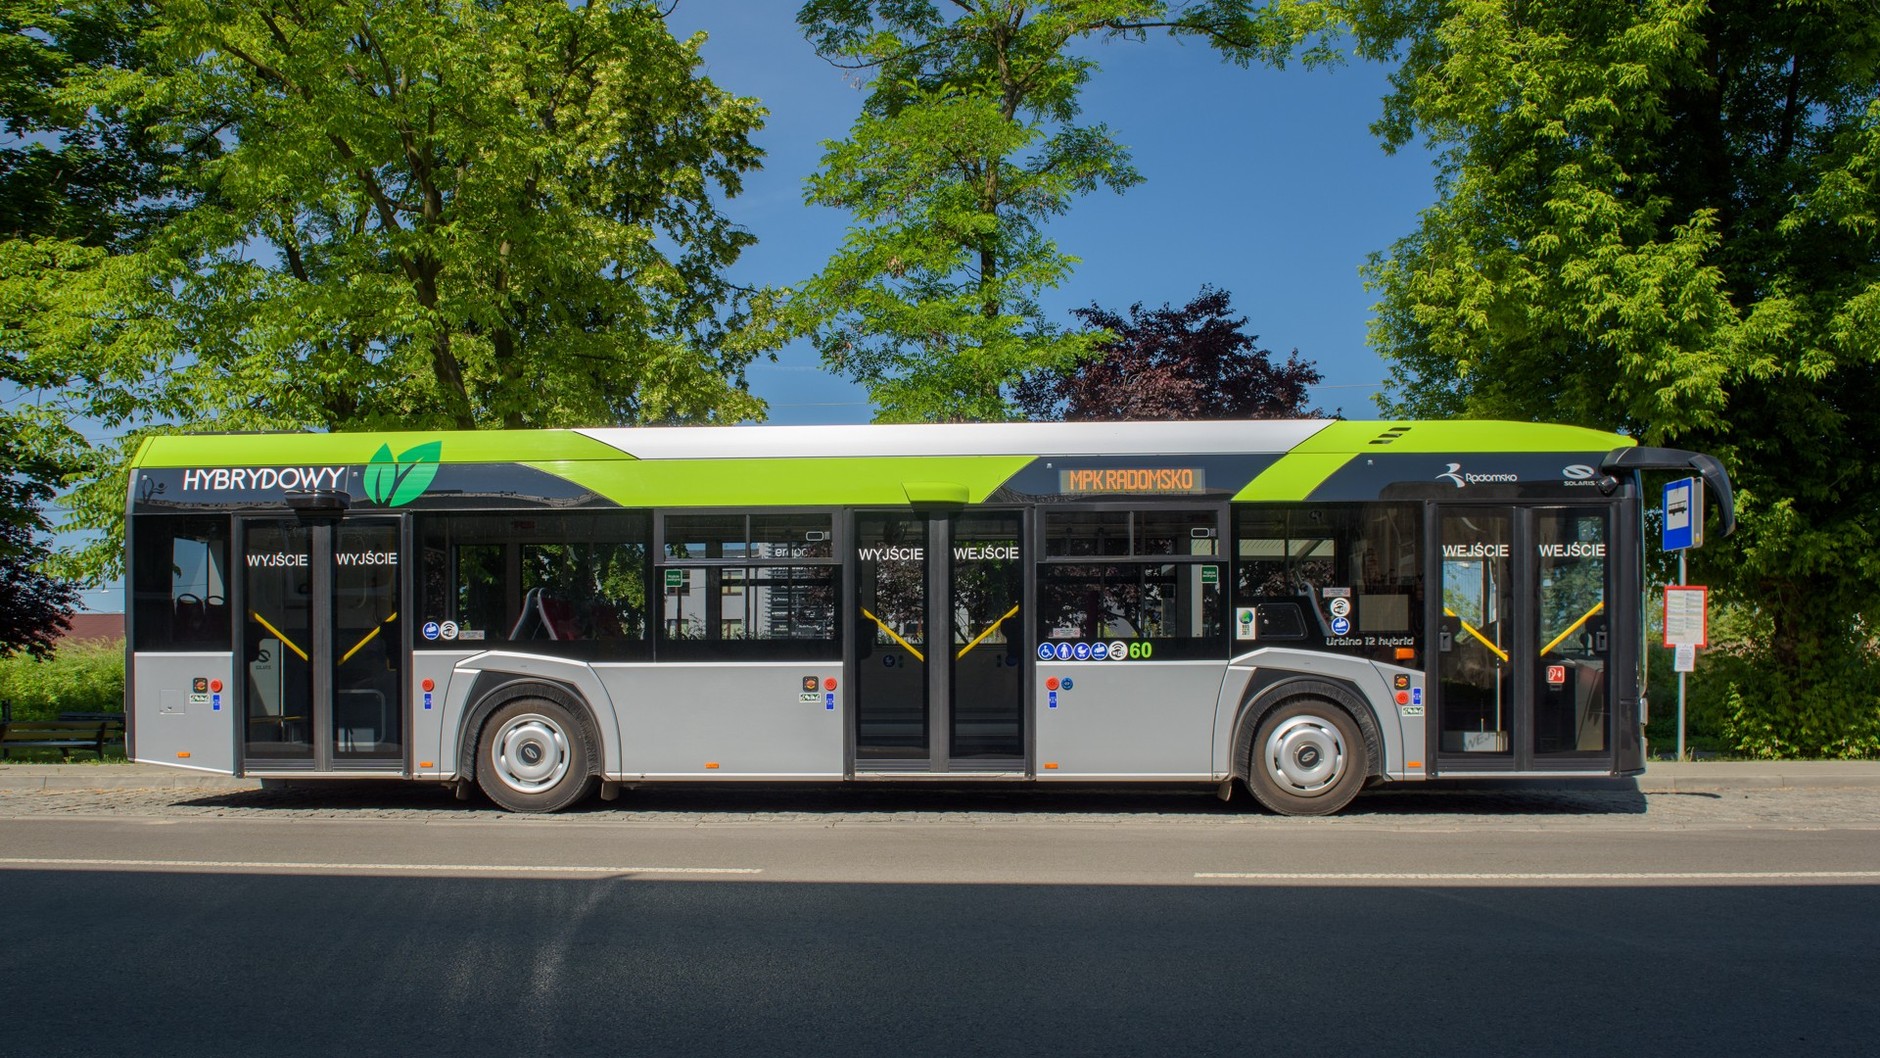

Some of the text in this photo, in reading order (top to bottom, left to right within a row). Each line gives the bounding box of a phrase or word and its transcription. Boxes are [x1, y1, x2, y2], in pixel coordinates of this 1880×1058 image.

[182, 467, 345, 491] HYBRYDOWY
[1069, 468, 1193, 490] MPK RADOMSKO
[1465, 472, 1518, 485] Radomsko
[858, 544, 924, 561] WYJŚCIE
[953, 543, 1020, 560] WEJŚCIE
[1442, 541, 1510, 557] WEJŚCIE
[1538, 541, 1606, 557] WEJŚCIE
[246, 552, 309, 567] WYJŚCIE
[335, 550, 398, 565] WYJŚCIE
[1129, 641, 1152, 659] 60
[1326, 637, 1414, 647] Urbino 12 hybrid
